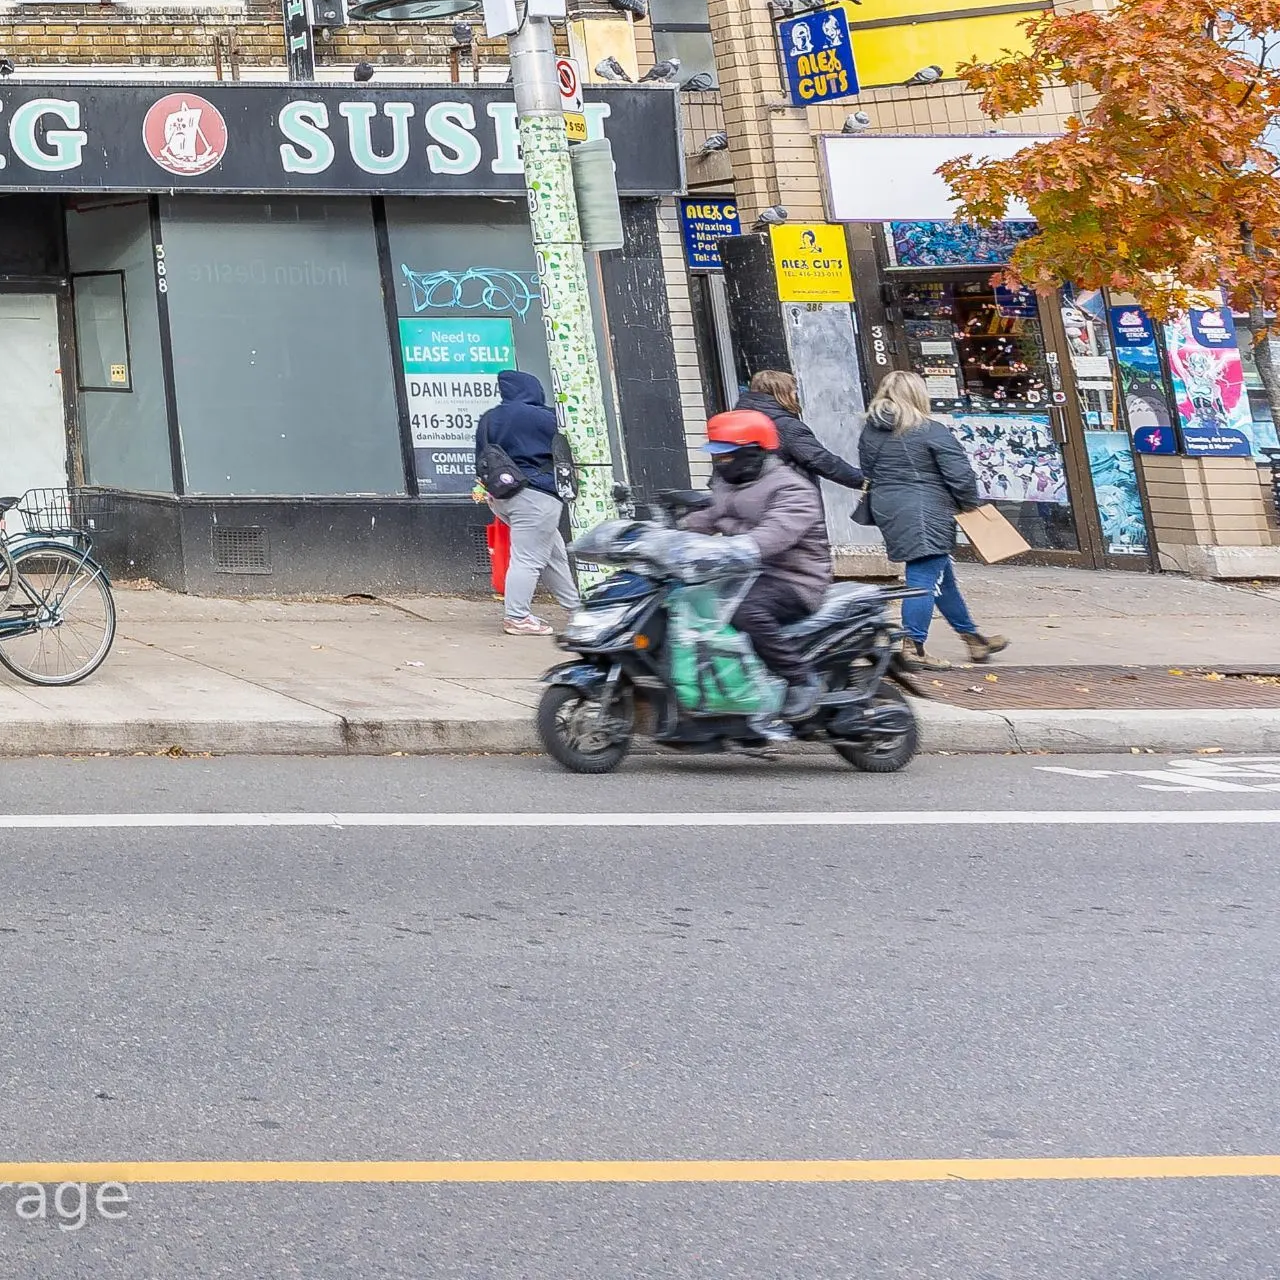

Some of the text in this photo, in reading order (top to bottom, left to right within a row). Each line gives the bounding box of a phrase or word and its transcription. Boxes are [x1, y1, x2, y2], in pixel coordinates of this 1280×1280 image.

[797, 48, 842, 76] ALEX
[798, 70, 848, 99] CUTS
[686, 205, 722, 220] ALEX
[694, 222, 732, 233] Waxing
[698, 242, 718, 250] Ped
[711, 254, 722, 262] 41
[155, 244, 168, 293] 388
[782, 260, 842, 269] ALEX CUTS
[806, 303, 822, 312] 386
[432, 332, 480, 343] Need to
[871, 325, 888, 365] 386
[405, 346, 510, 362] LEASE or SELL?
[410, 382, 500, 398] DANI HABBA
[411, 414, 480, 429] 416-303-
[416, 432, 476, 442] danihabbal@g
[432, 452, 476, 463] COMME
[436, 465, 464, 475] REAL
